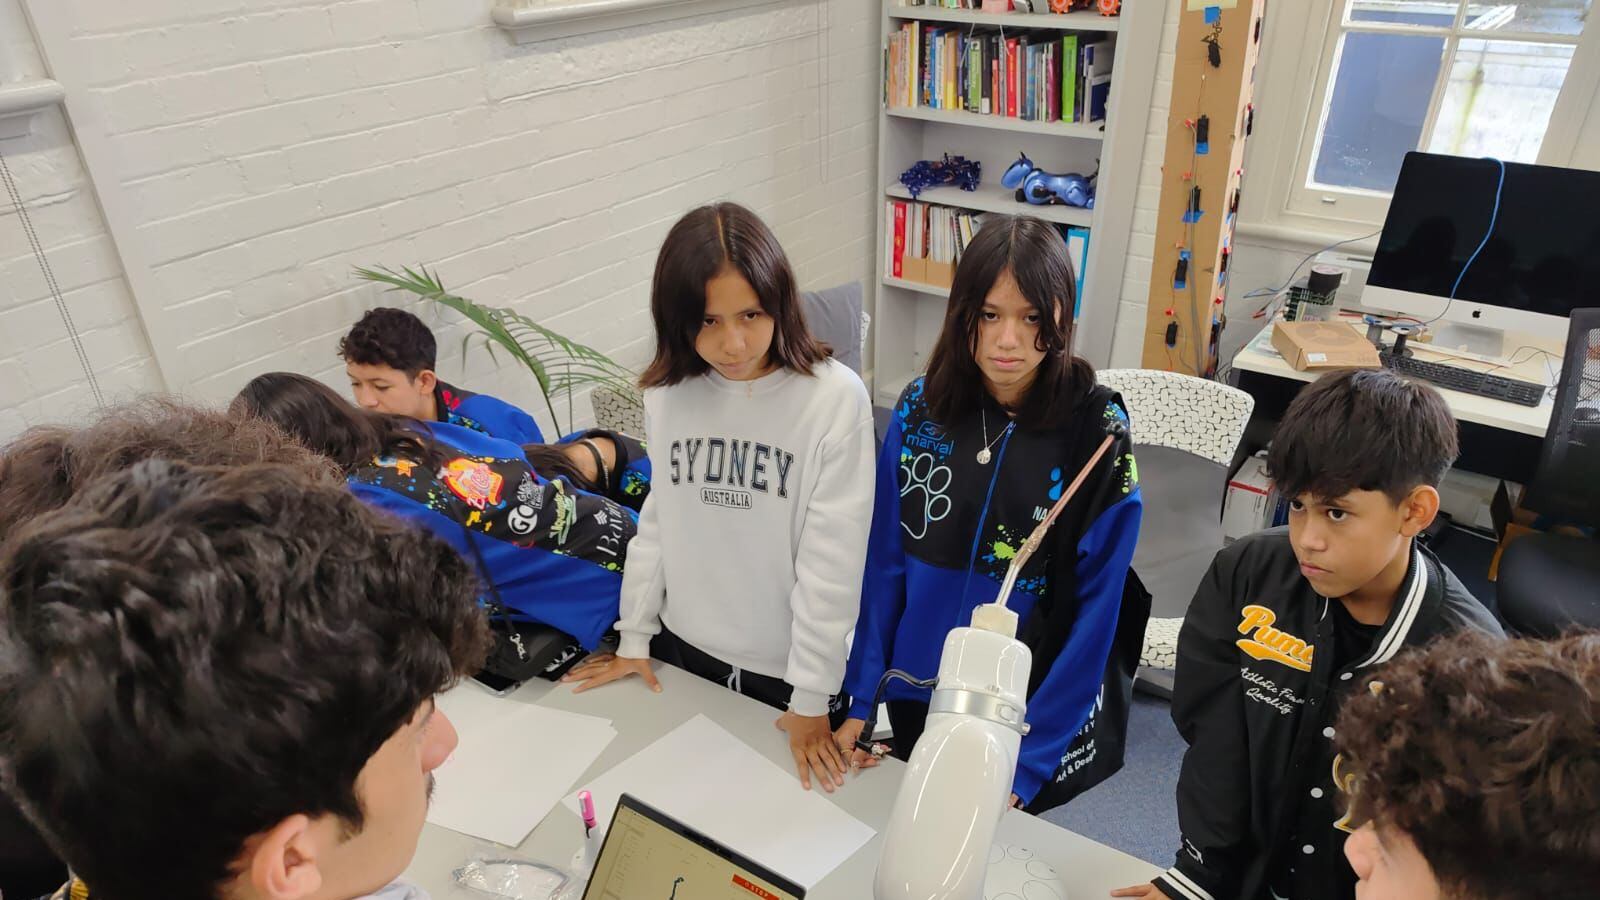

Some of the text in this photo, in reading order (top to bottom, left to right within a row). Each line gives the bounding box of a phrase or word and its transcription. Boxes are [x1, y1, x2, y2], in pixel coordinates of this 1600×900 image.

[906, 433, 955, 455] marval
[670, 437, 794, 499] SYDNEY
[703, 489, 750, 507] AUSTRALIA
[508, 503, 538, 535] GO
[1246, 687, 1293, 715] Quality
